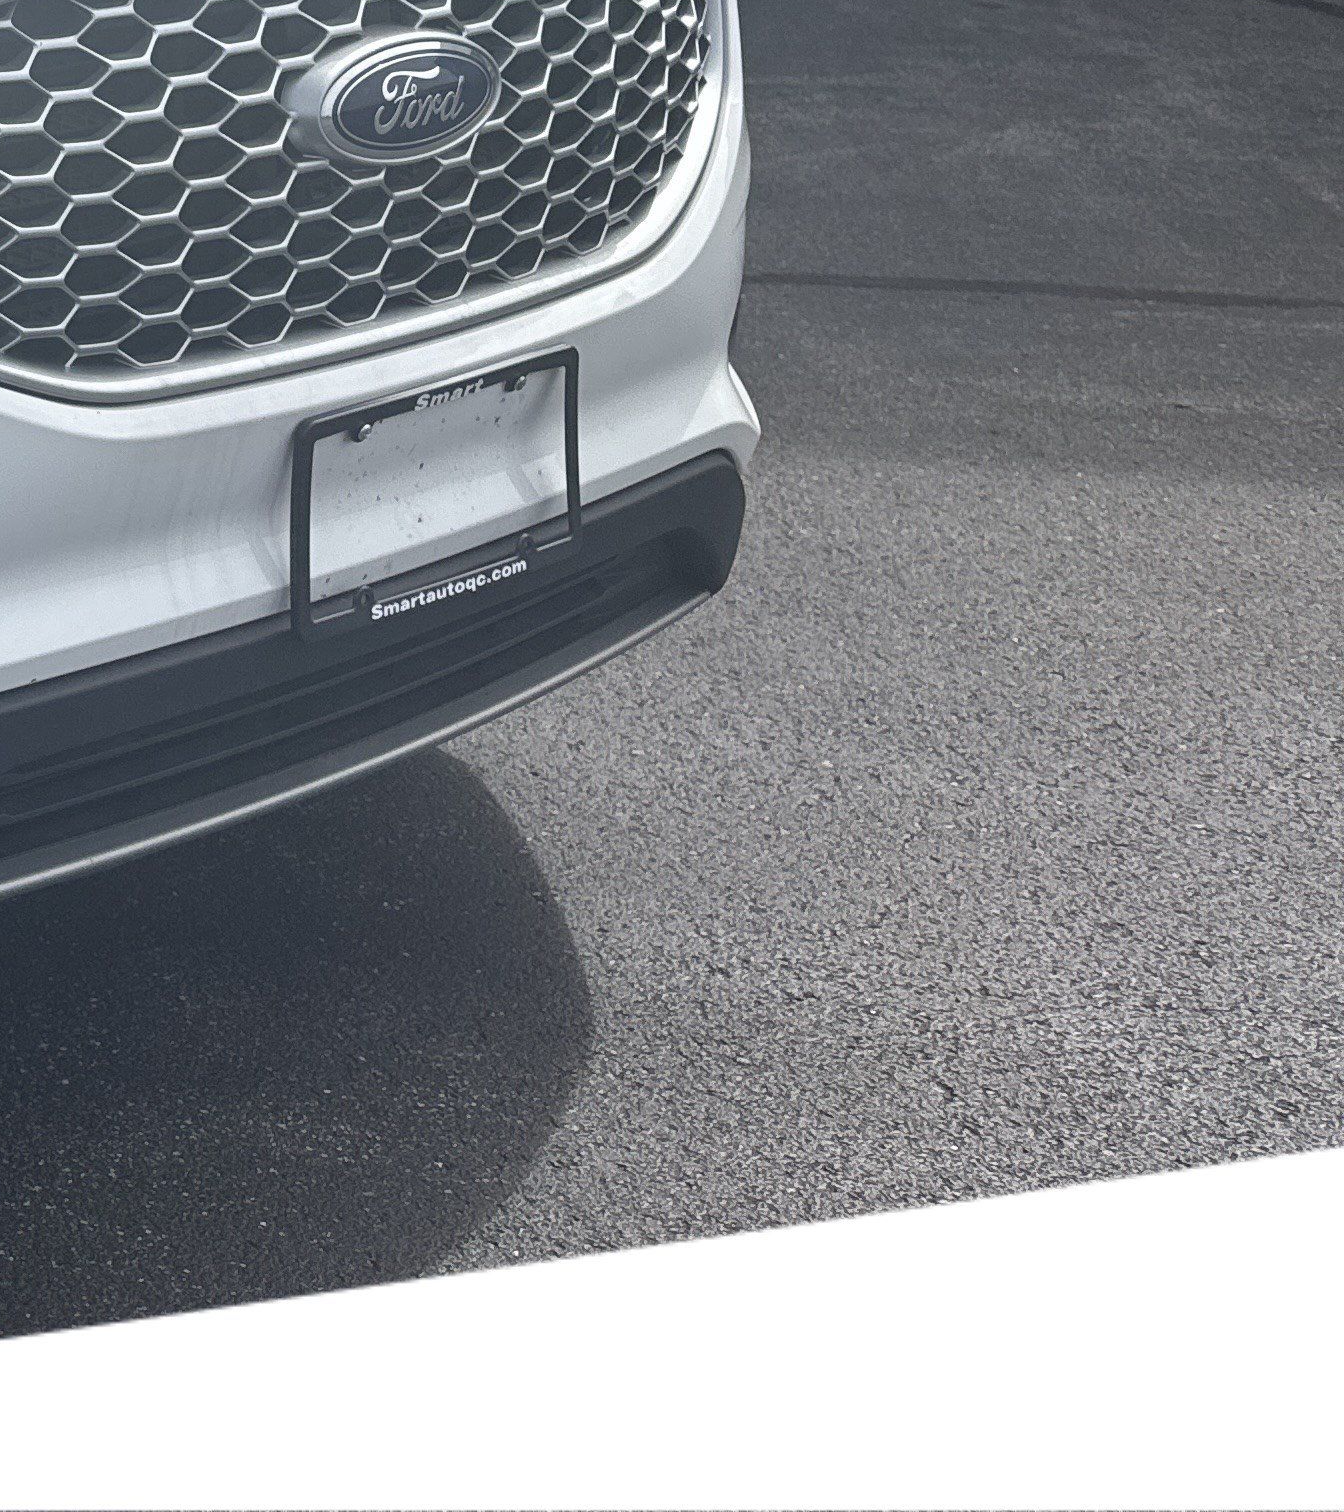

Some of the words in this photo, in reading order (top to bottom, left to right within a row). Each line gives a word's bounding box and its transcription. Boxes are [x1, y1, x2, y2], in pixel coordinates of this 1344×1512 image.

[374, 65, 465, 135] Ford
[414, 378, 484, 411] Smart
[371, 559, 528, 621] Smartautoqc.com
